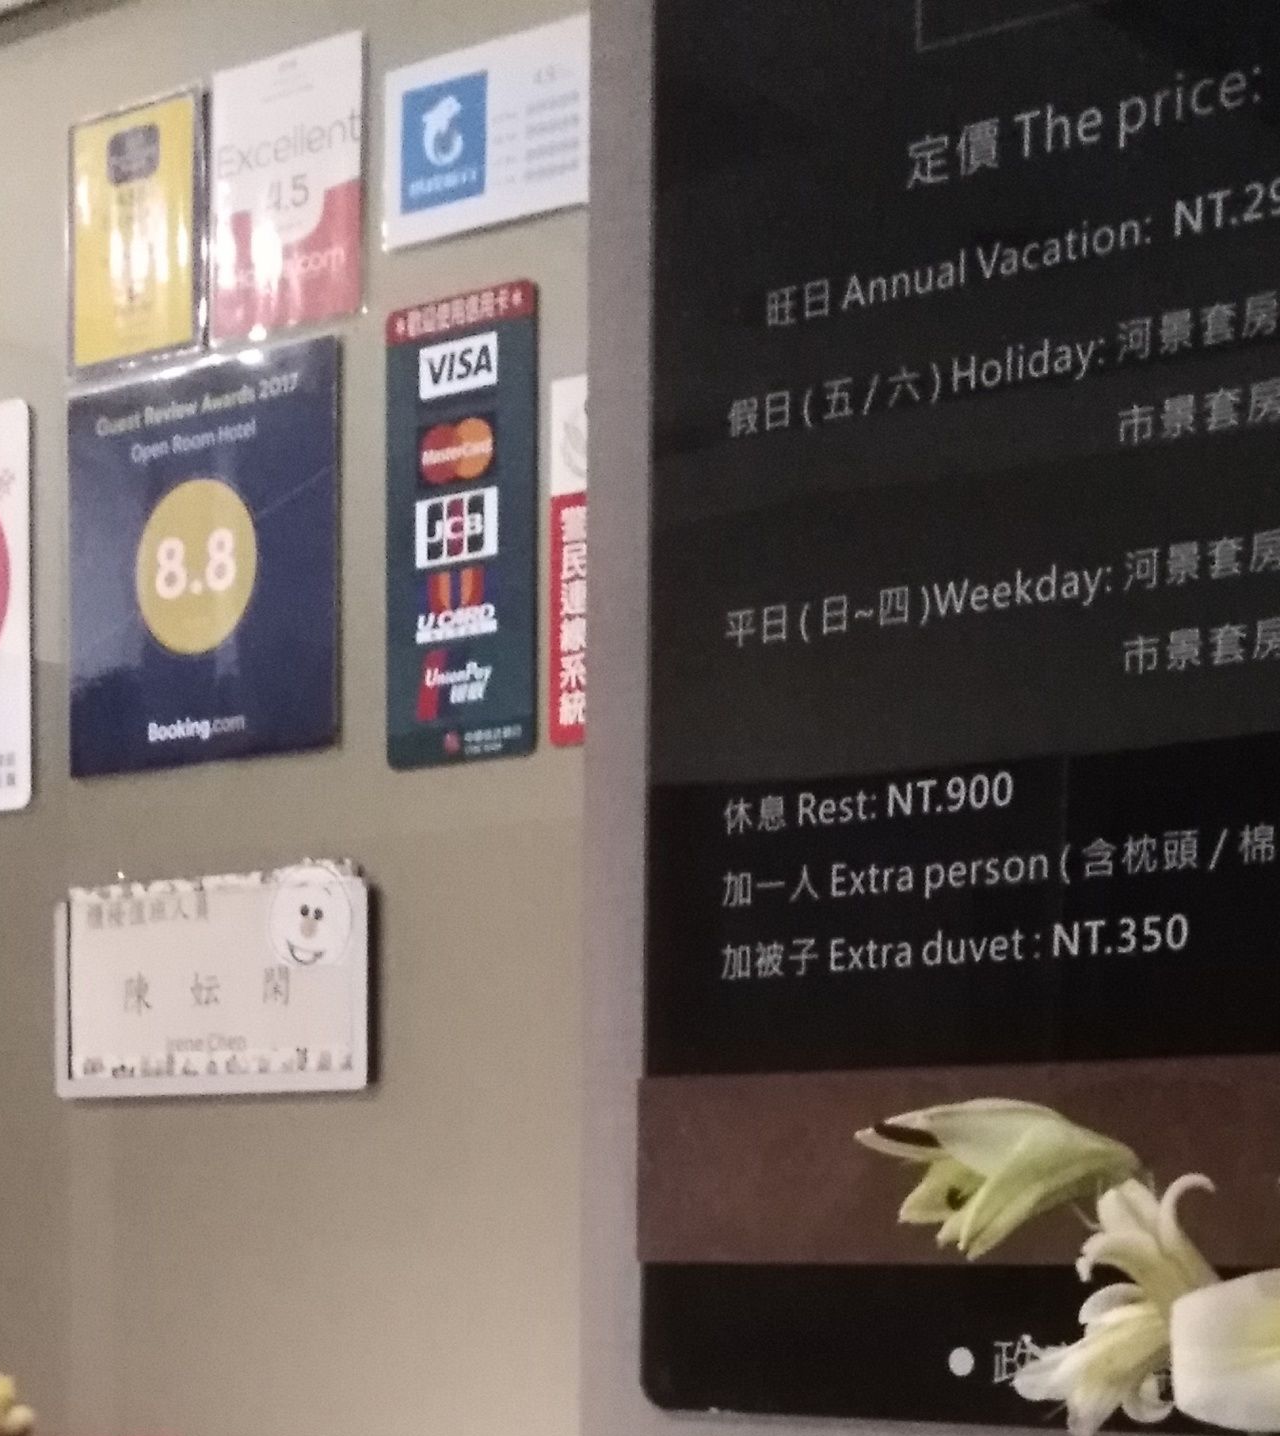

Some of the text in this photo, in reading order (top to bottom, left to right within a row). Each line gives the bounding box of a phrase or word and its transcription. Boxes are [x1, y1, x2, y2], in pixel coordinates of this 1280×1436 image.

[216, 107, 360, 180] Excellent
[907, 118, 1000, 189] 定價
[1014, 103, 1103, 159] The
[1119, 64, 1262, 149] price:
[766, 284, 830, 327] 旺日
[841, 248, 966, 311] Annual
[976, 215, 1152, 281] Vacation:
[428, 344, 493, 385] VISA
[951, 337, 1107, 394] Holiday:
[96, 411, 142, 438] Guest
[144, 400, 198, 426] Review
[201, 384, 256, 413] Awards
[131, 417, 257, 464] Open Room Hotel
[426, 512, 486, 544] JCB
[155, 527, 237, 601] 8.8
[148, 713, 245, 743] Booking.com
[722, 770, 1015, 836] 休息 Rest: NT.900
[721, 863, 820, 908] 加一人
[830, 861, 915, 899] Extra
[923, 850, 1050, 900] person
[720, 937, 820, 981] 加被子
[829, 937, 914, 973] Extra
[1051, 911, 1191, 958] NT.350
